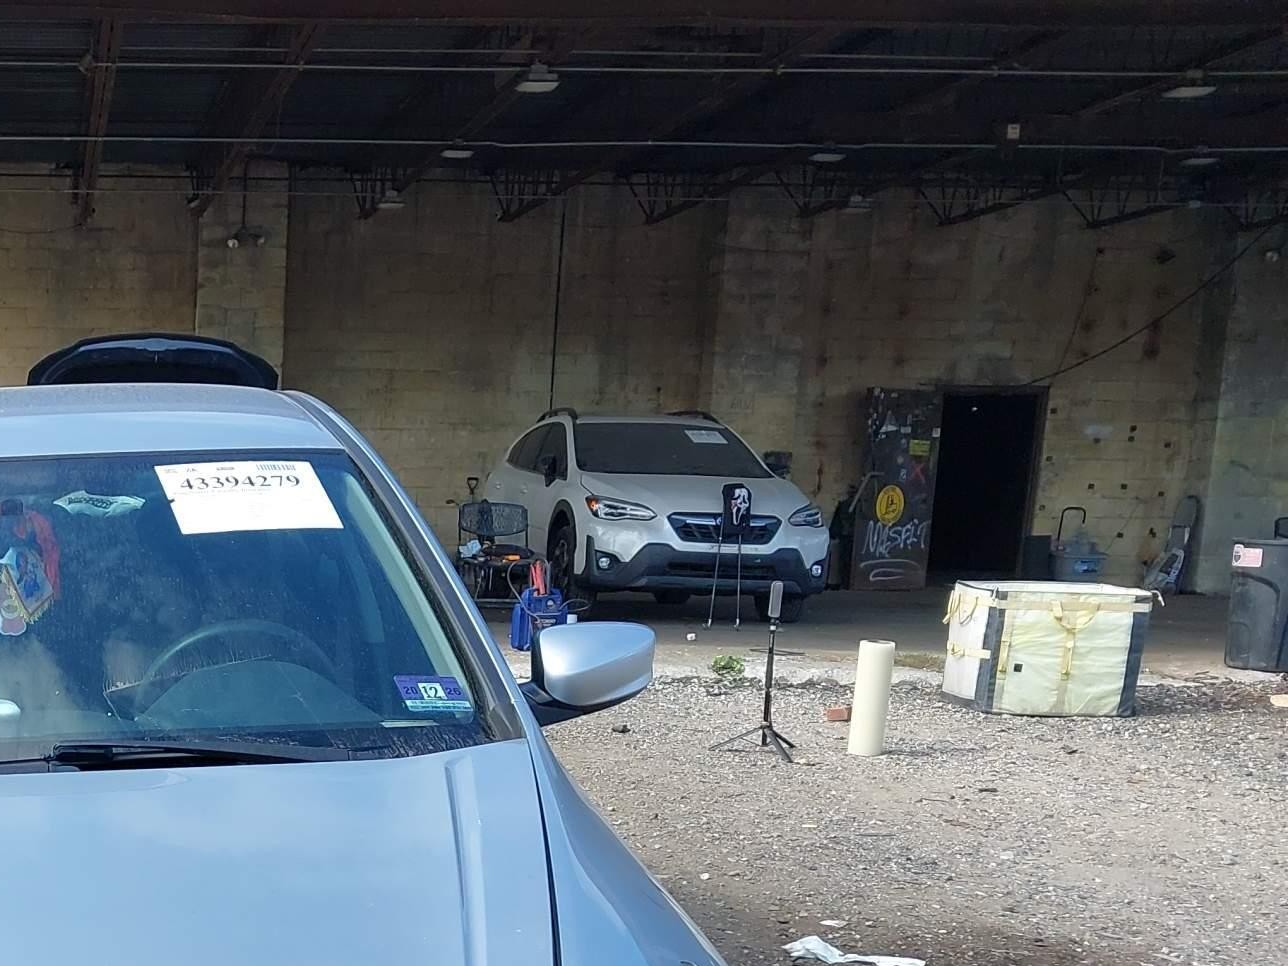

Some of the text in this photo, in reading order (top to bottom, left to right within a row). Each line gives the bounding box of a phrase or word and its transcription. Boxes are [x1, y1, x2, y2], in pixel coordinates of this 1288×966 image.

[180, 475, 300, 490] 43394279
[403, 686, 418, 695] 20
[421, 685, 443, 699] 12
